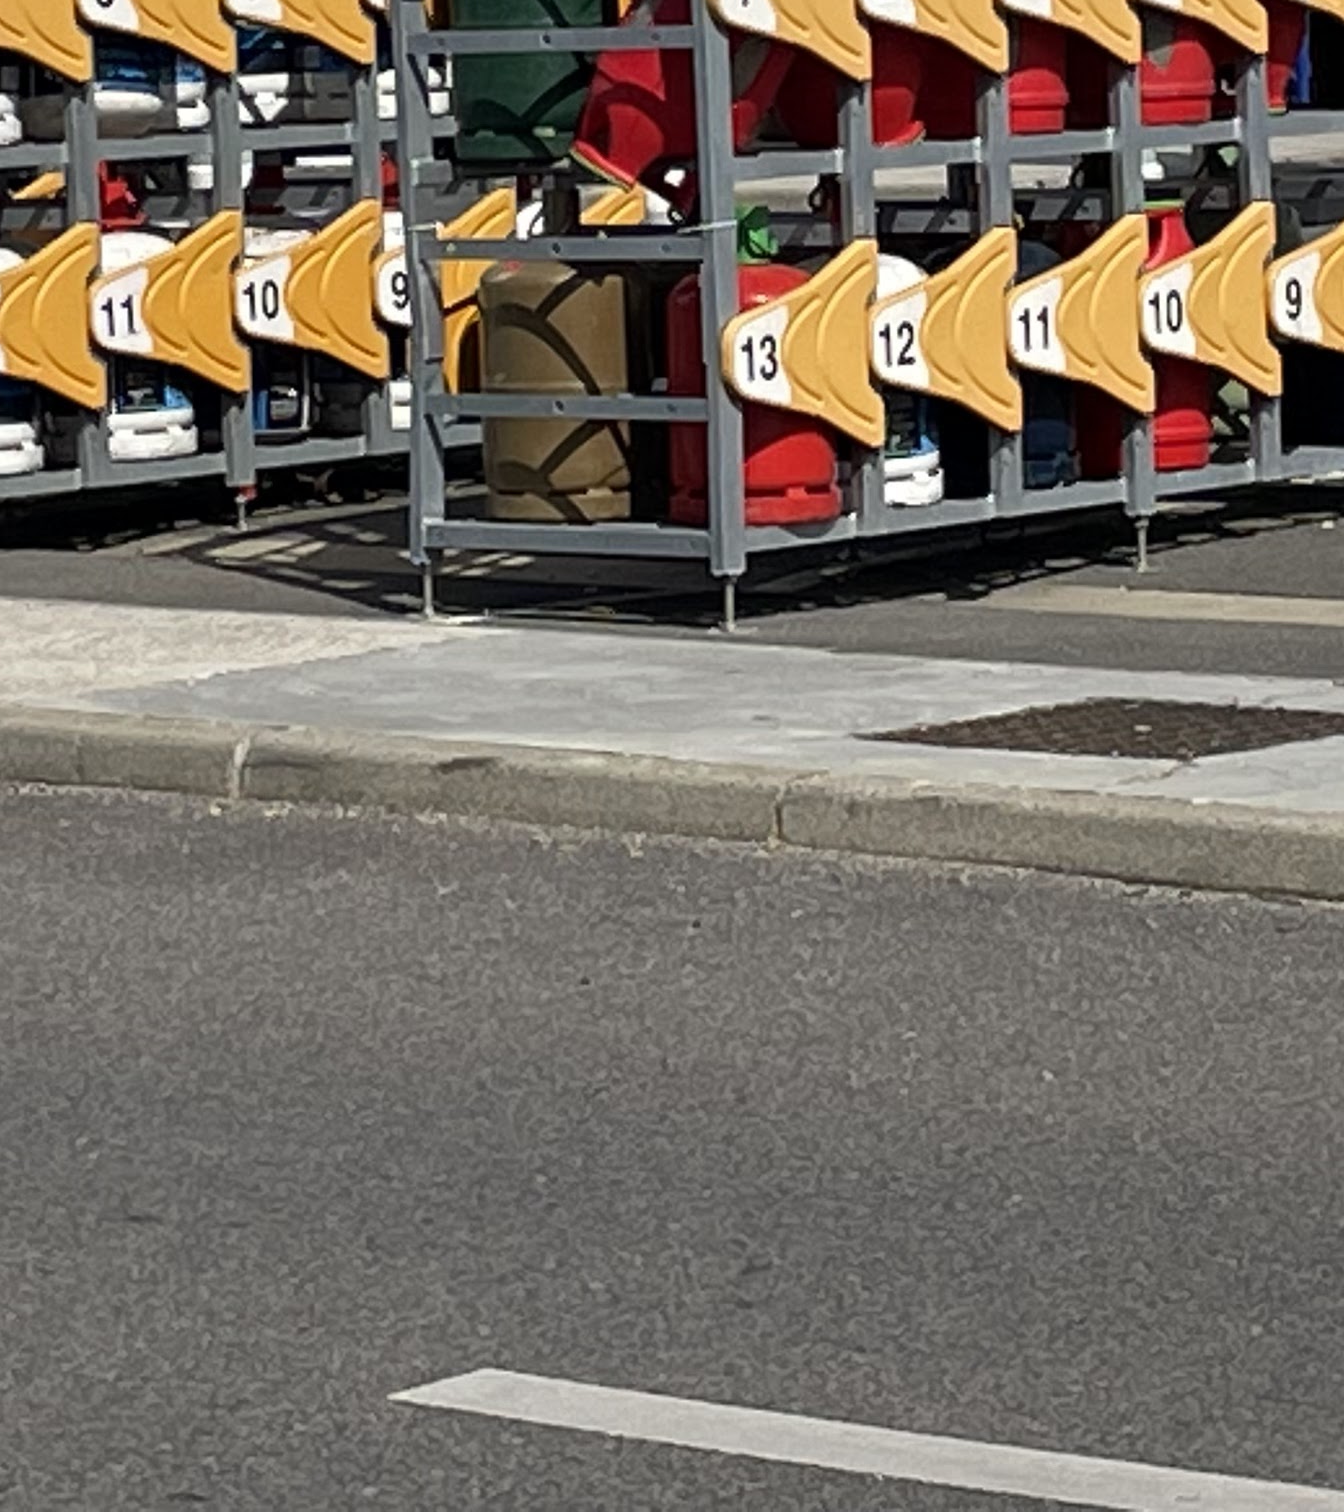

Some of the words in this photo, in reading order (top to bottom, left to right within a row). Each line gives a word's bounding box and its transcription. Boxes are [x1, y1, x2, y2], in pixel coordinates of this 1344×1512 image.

[242, 279, 279, 320] 10
[391, 271, 410, 310] 9
[1148, 289, 1183, 334] 10
[1285, 278, 1303, 321] 9
[100, 294, 137, 337] 11
[1018, 306, 1049, 352] 11
[740, 335, 778, 381] 13
[878, 320, 916, 367] 12
